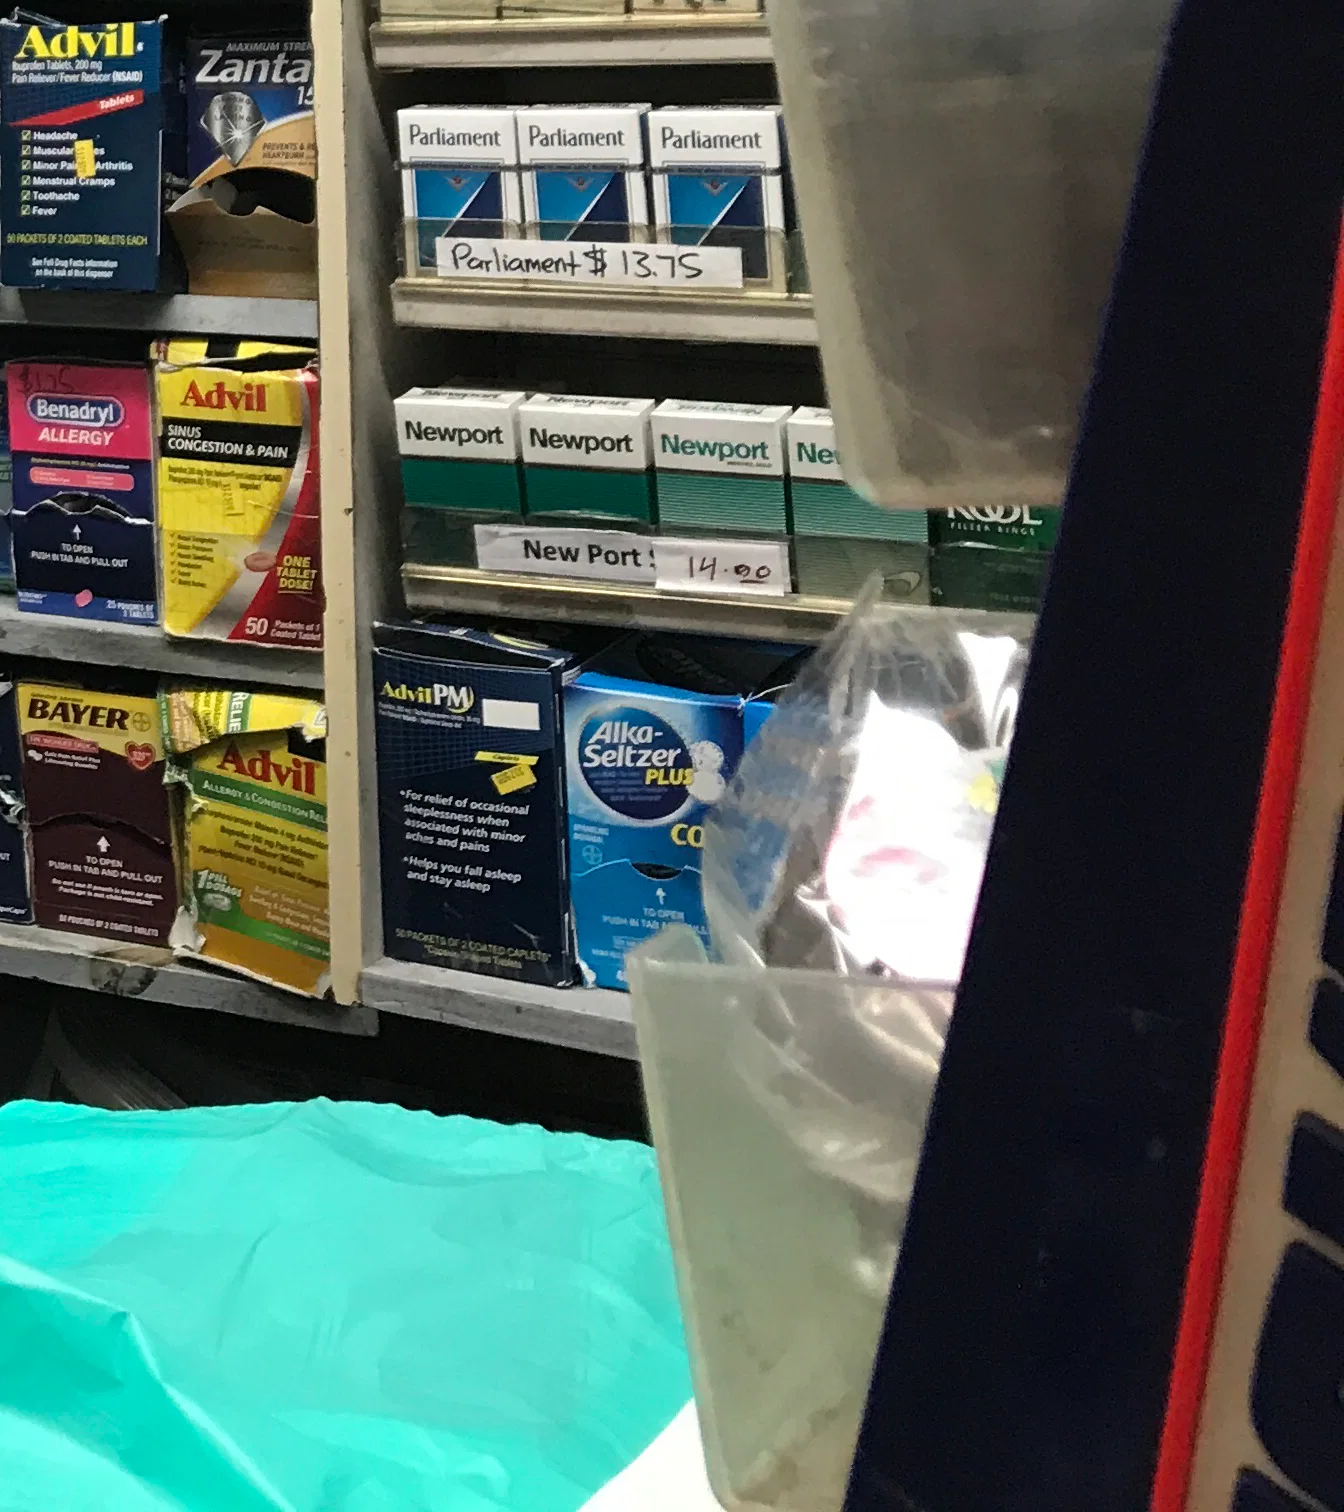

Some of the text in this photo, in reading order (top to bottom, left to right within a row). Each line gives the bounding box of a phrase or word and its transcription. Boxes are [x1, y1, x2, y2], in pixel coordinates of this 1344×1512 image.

[99, 93, 135, 111] Tablets
[410, 124, 501, 147] Parliament
[529, 125, 625, 148] Parliament
[661, 127, 762, 150] Parliament
[33, 176, 115, 188] Menstrual Cramps
[33, 191, 80, 201] Toothache
[33, 205, 57, 216] Fever
[451, 242, 703, 279] Parliament $ 13.75
[36, 398, 114, 423] Benadryl
[38, 427, 113, 446] ALLERGY
[168, 424, 202, 438] SINUS
[405, 420, 504, 445] Newport
[529, 427, 633, 454] Newport
[168, 437, 289, 459] CONGESTION & PAIN
[661, 434, 769, 462] Newport
[283, 555, 311, 568] ONE
[522, 539, 642, 568] New Port
[276, 567, 317, 579] TABLET
[245, 617, 268, 635] 50
[27, 696, 131, 731] BAYER
[587, 719, 665, 747] Alka-
[582, 743, 683, 771] Seltzer
[404, 804, 509, 827] sleeplessness when
